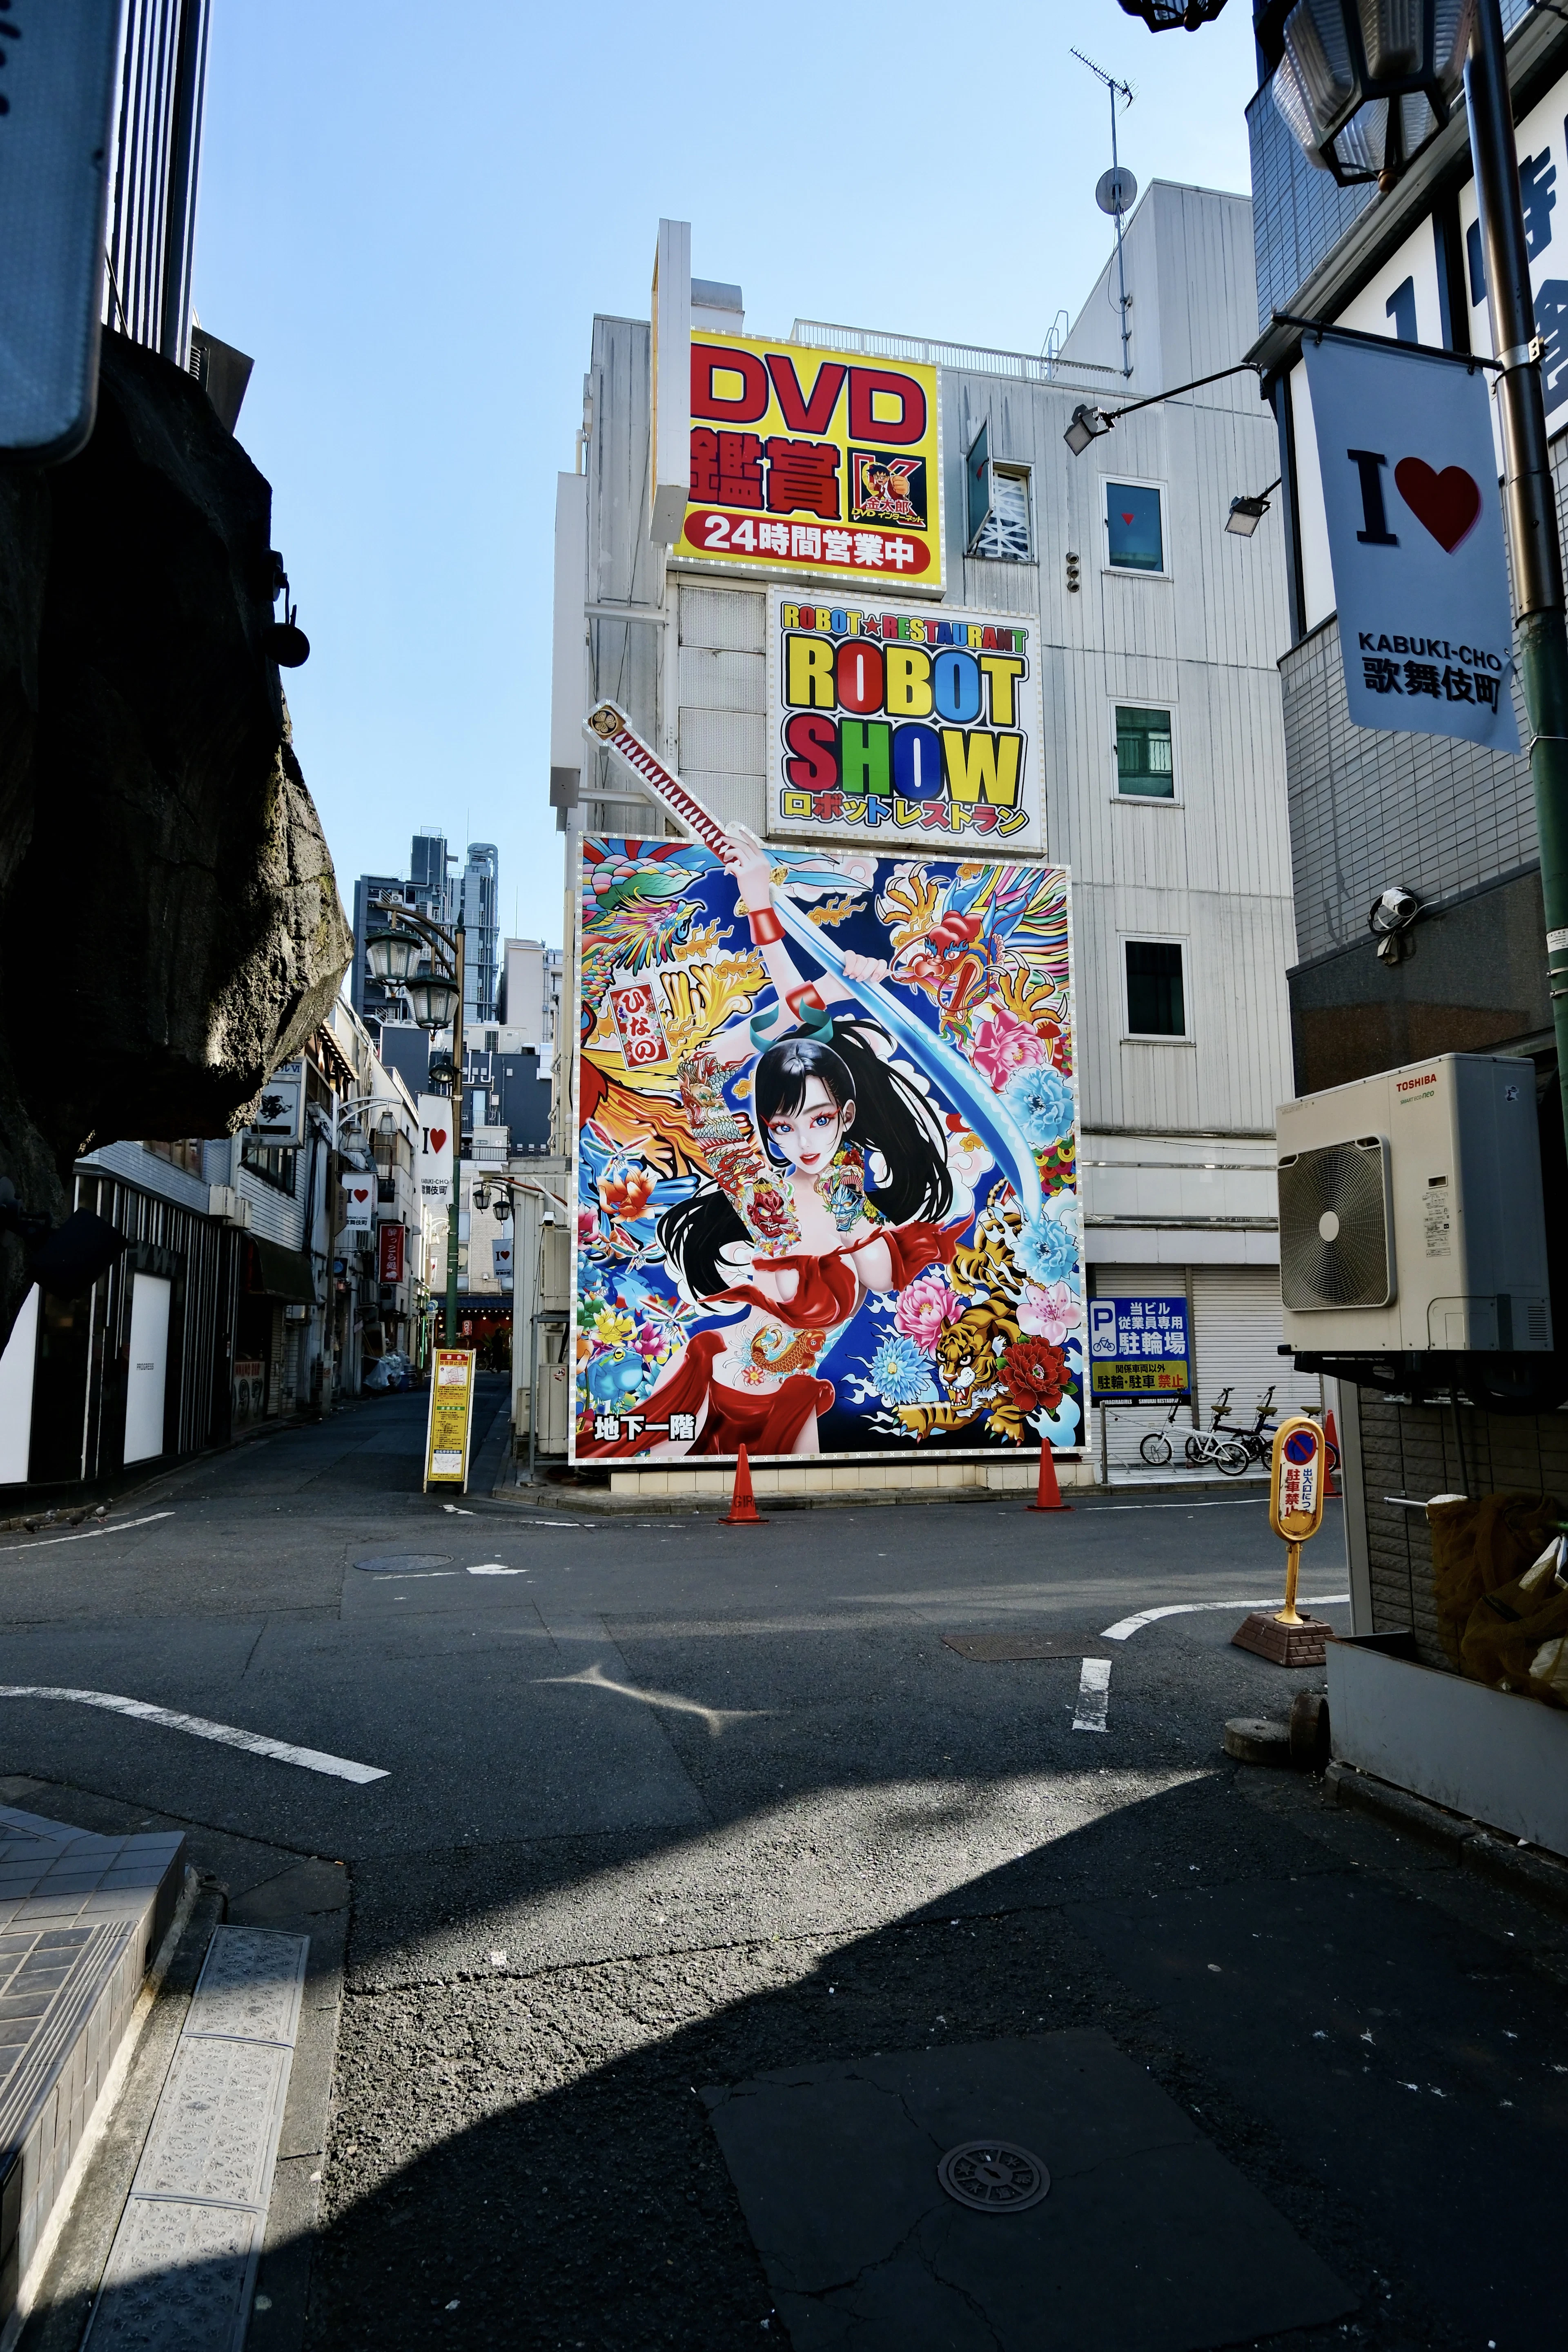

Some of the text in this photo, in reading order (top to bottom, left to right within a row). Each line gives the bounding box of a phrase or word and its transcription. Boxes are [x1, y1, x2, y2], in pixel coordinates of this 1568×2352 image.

[690, 342, 927, 445] DVD
[690, 427, 841, 521] 鑑賞
[866, 496, 913, 514] 金太郎
[1347, 449, 1398, 546] I
[851, 508, 924, 523] DVD インターネット
[704, 514, 914, 569] 24時間営業中
[783, 603, 1028, 654] ROBOT RESTAURANT
[1358, 632, 1503, 672] KABUKI-CHO
[786, 633, 1026, 727] ROBOT
[1361, 656, 1501, 713] 歌舞伎町
[786, 713, 1023, 807] SHOW
[783, 791, 1027, 835] ロボットレストラン
[622, 991, 656, 1059] ひなの
[1396, 1074, 1437, 1092] TOSHIBA
[1422, 1090, 1434, 1098] neo
[422, 1127, 430, 1154] I
[347, 1189, 353, 1203] I
[422, 1185, 447, 1195] 歌舞伎町
[495, 1251, 501, 1261] I
[1094, 1308, 1113, 1331] P
[1130, 1302, 1170, 1315] 当ビル
[1118, 1316, 1183, 1330] 従業員専用
[1119, 1332, 1185, 1355] 駐輪場
[1115, 1363, 1166, 1373] 関係車両以外
[1097, 1374, 1184, 1390] 駐輪・駐車 禁止
[595, 1414, 695, 1441] 地下一階
[1302, 1468, 1312, 1511] 出入口につ
